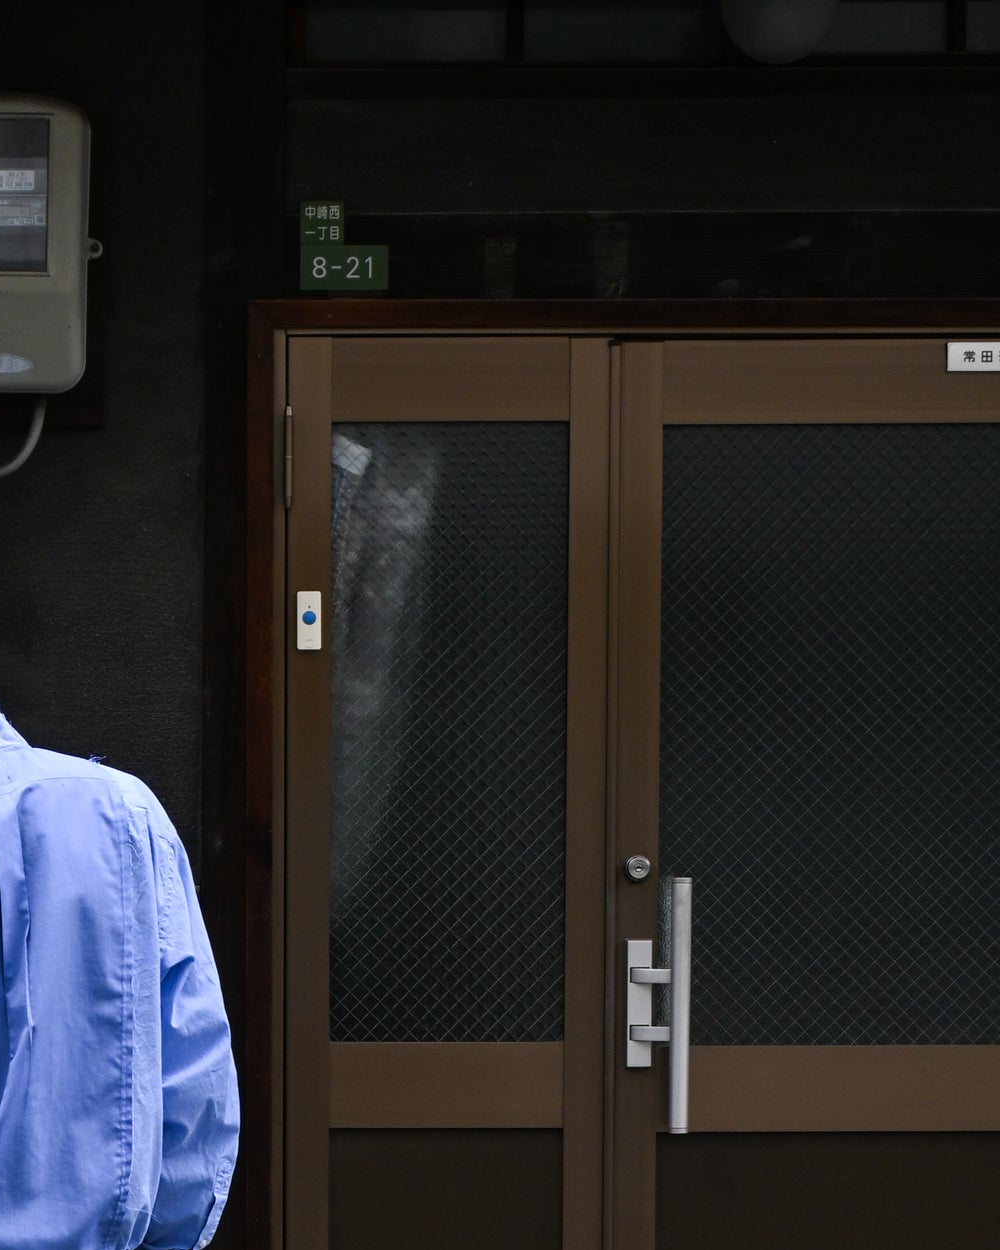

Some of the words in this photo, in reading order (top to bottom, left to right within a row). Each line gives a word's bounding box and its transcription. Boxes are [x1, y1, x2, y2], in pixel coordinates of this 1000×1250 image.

[305, 225, 339, 240] 一丁目
[312, 256, 373, 278] 8-21
[963, 350, 1000, 363] 常田
